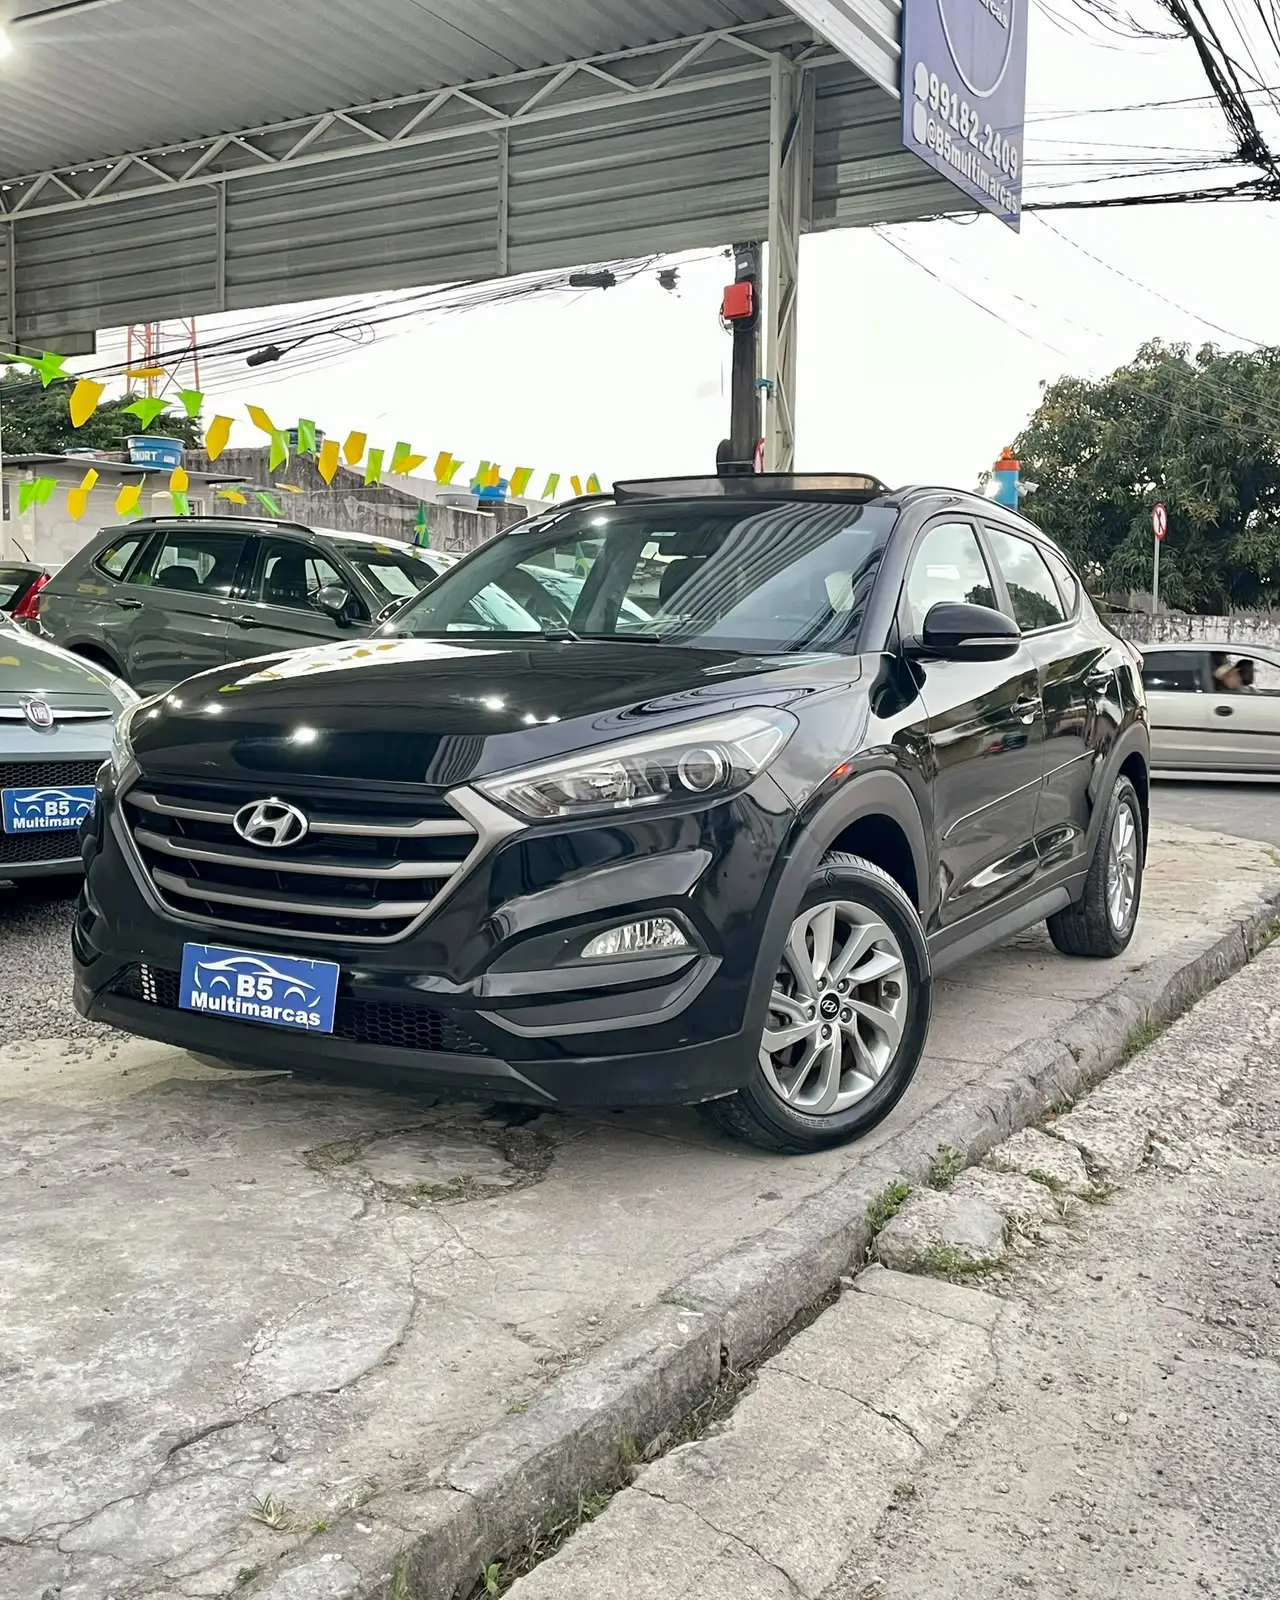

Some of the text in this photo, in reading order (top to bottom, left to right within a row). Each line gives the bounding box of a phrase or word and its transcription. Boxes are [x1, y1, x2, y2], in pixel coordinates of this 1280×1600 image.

[929, 72, 1018, 180] 99182.2409
[926, 118, 1018, 214] @B5multimarcas
[13, 817, 84, 829] Multimarc
[44, 801, 70, 816] B5
[236, 974, 273, 1001] B5
[191, 990, 321, 1026] Multimarcas
